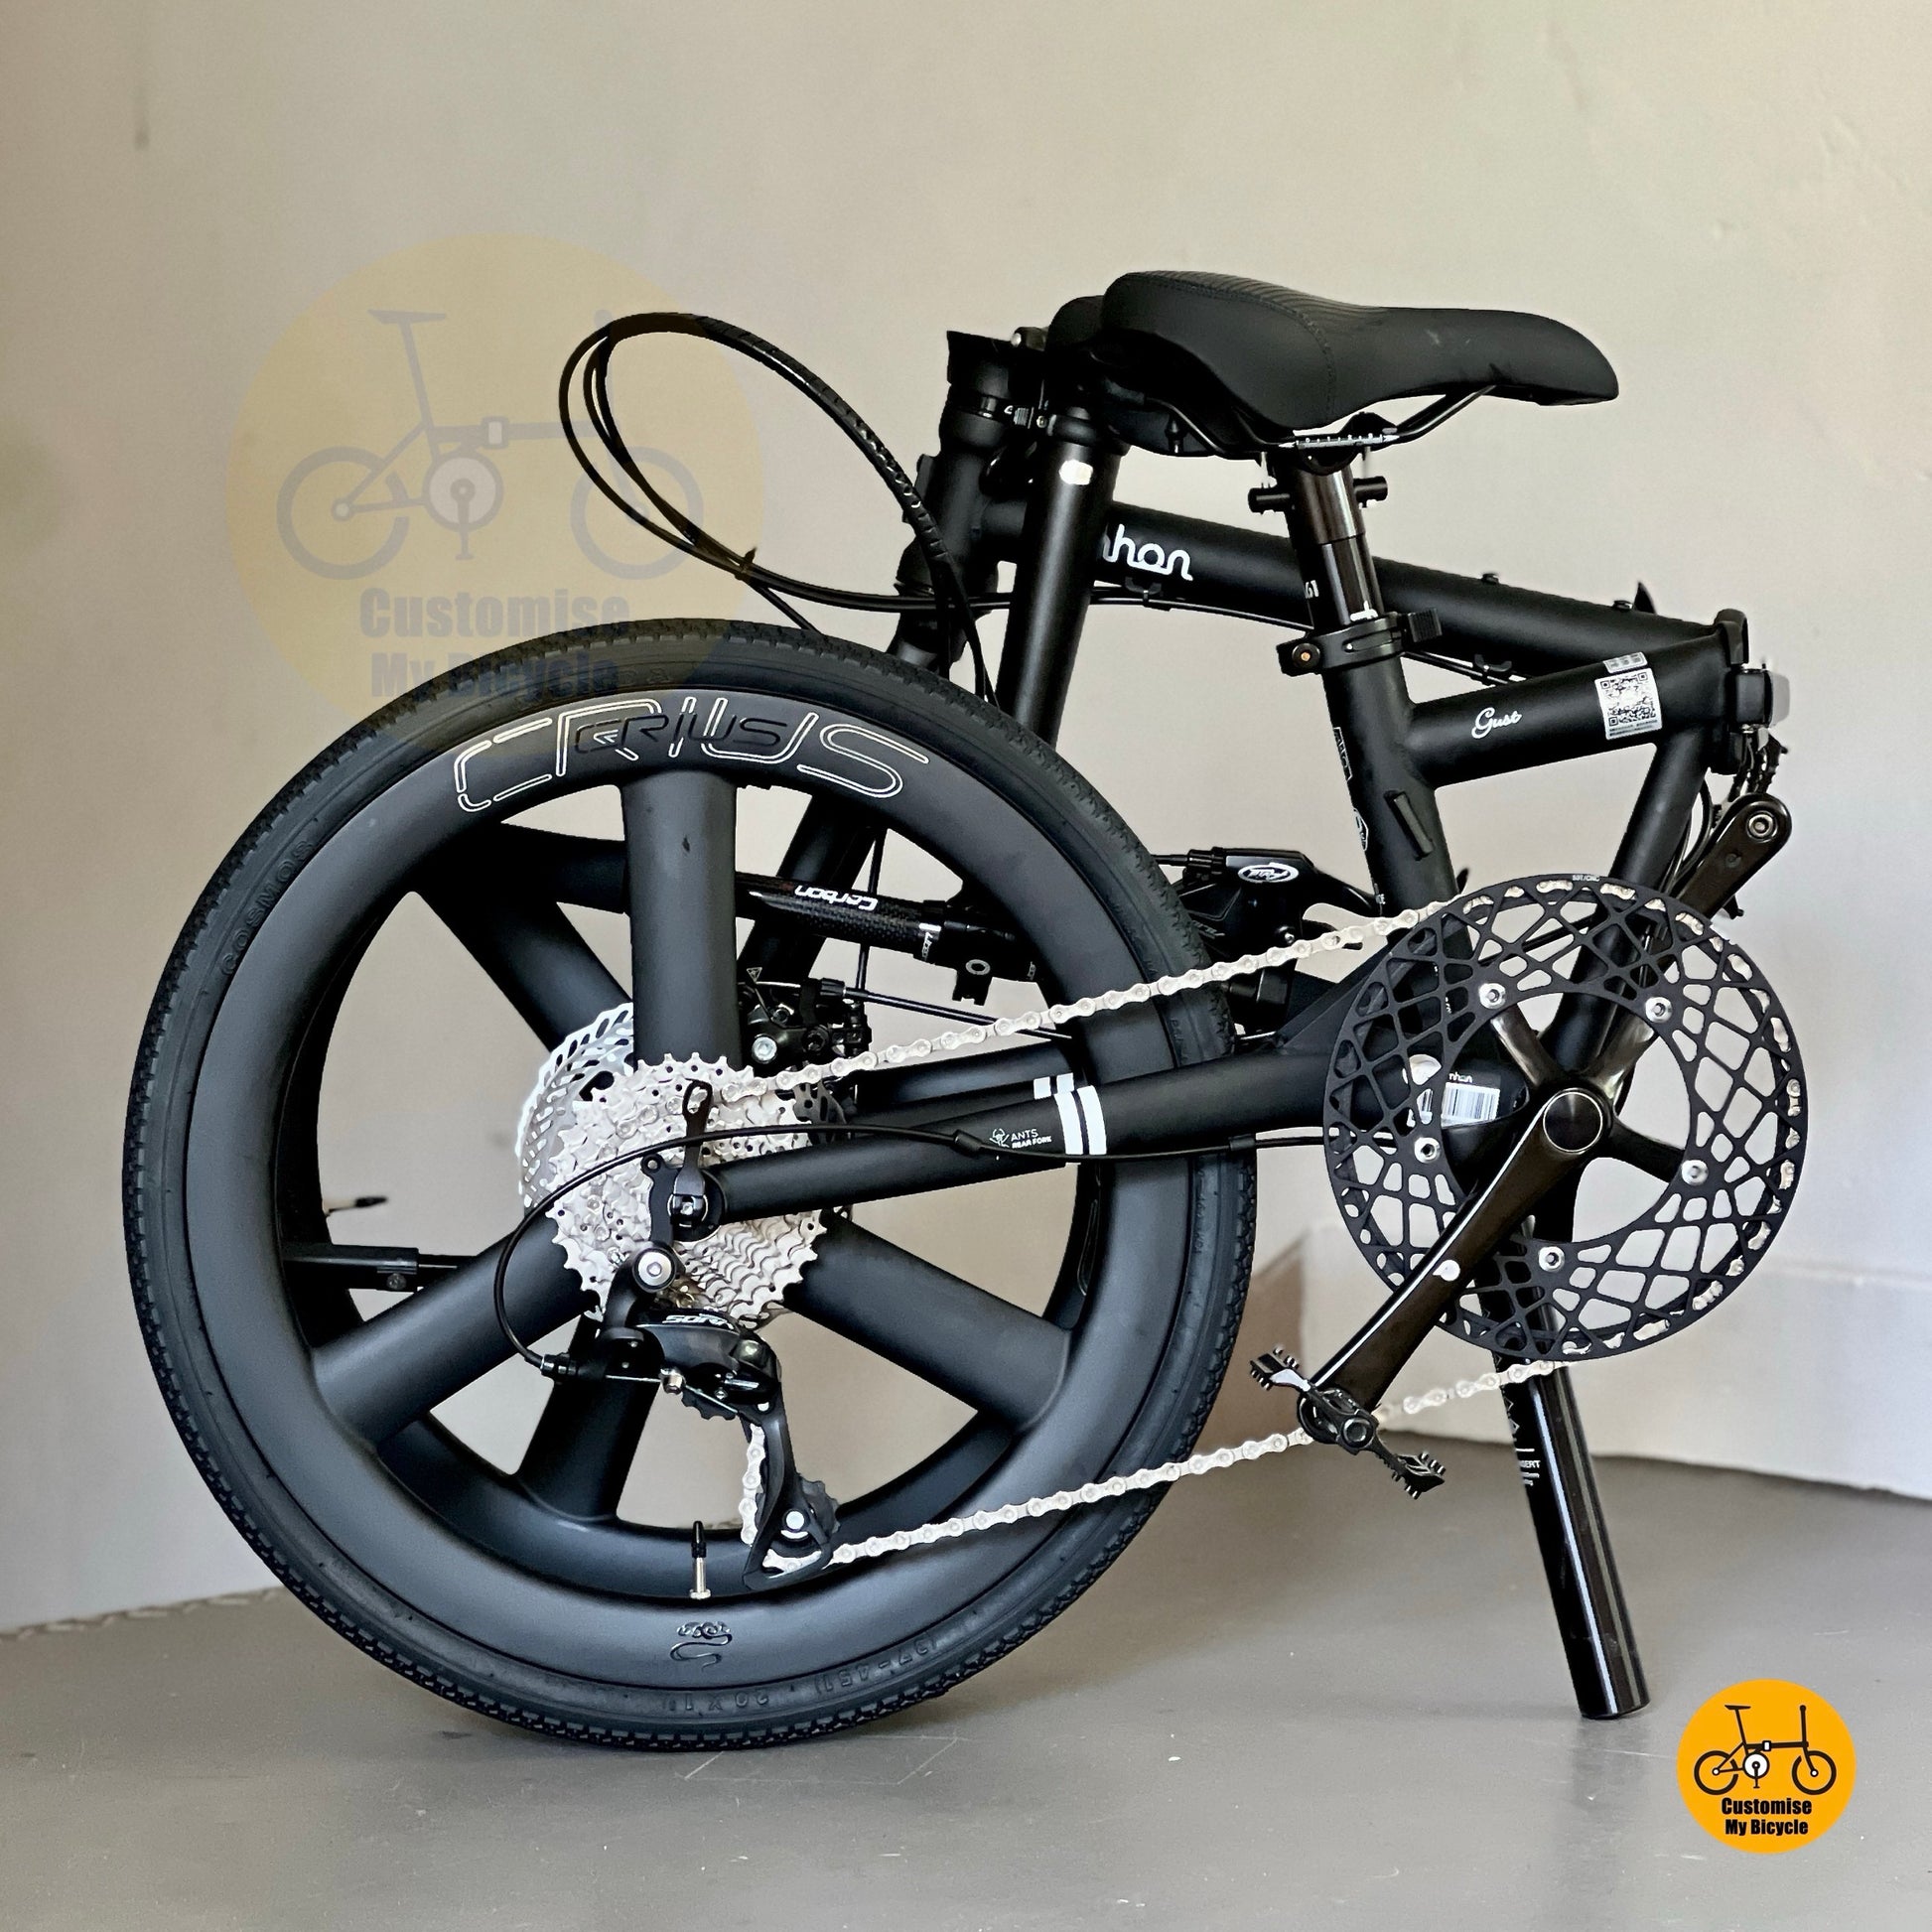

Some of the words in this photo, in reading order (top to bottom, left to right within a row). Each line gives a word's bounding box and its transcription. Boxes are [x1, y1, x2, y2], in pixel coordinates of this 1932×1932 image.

[1471, 707, 1522, 739] Gust
[220, 841, 316, 975] COSMOS
[1011, 1128, 1039, 1143] ANTS
[1033, 1135, 1052, 1146] FORK
